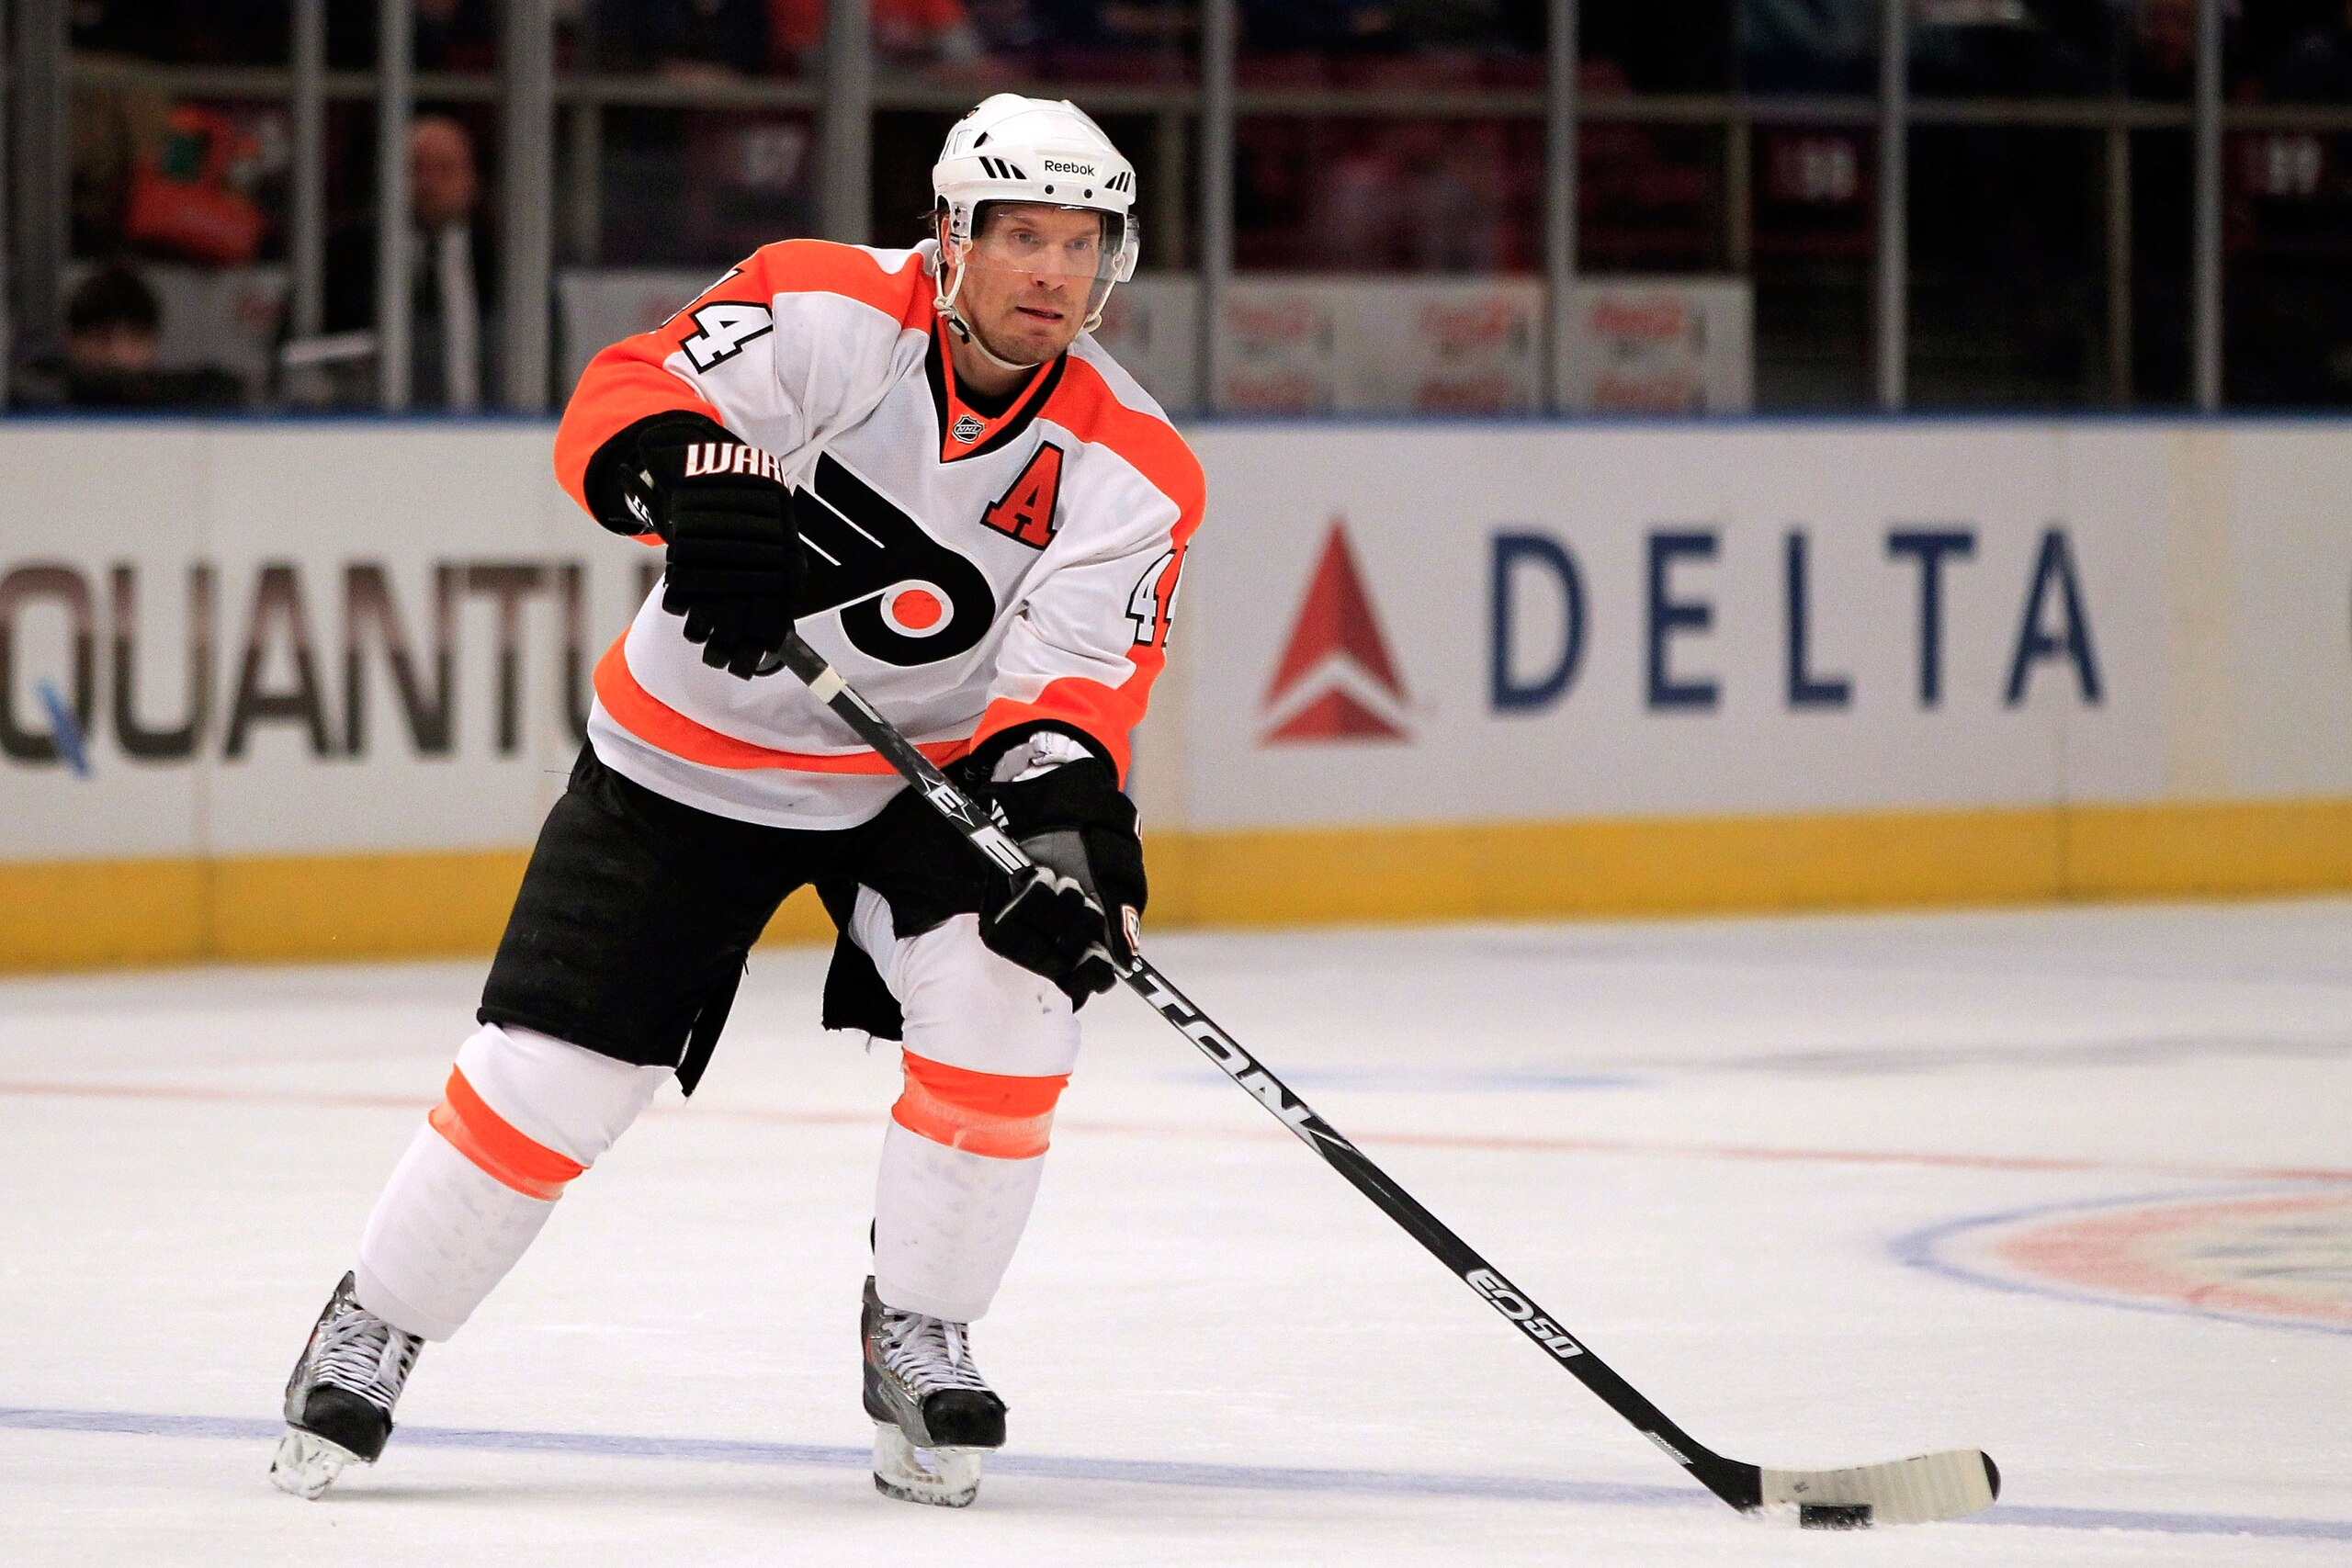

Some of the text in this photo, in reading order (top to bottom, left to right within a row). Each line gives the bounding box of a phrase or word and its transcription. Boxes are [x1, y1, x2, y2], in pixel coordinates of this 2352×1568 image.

[1045, 160, 1095, 176] Reebok
[979, 440, 1064, 551] A
[1488, 525, 2104, 715] DELTA
